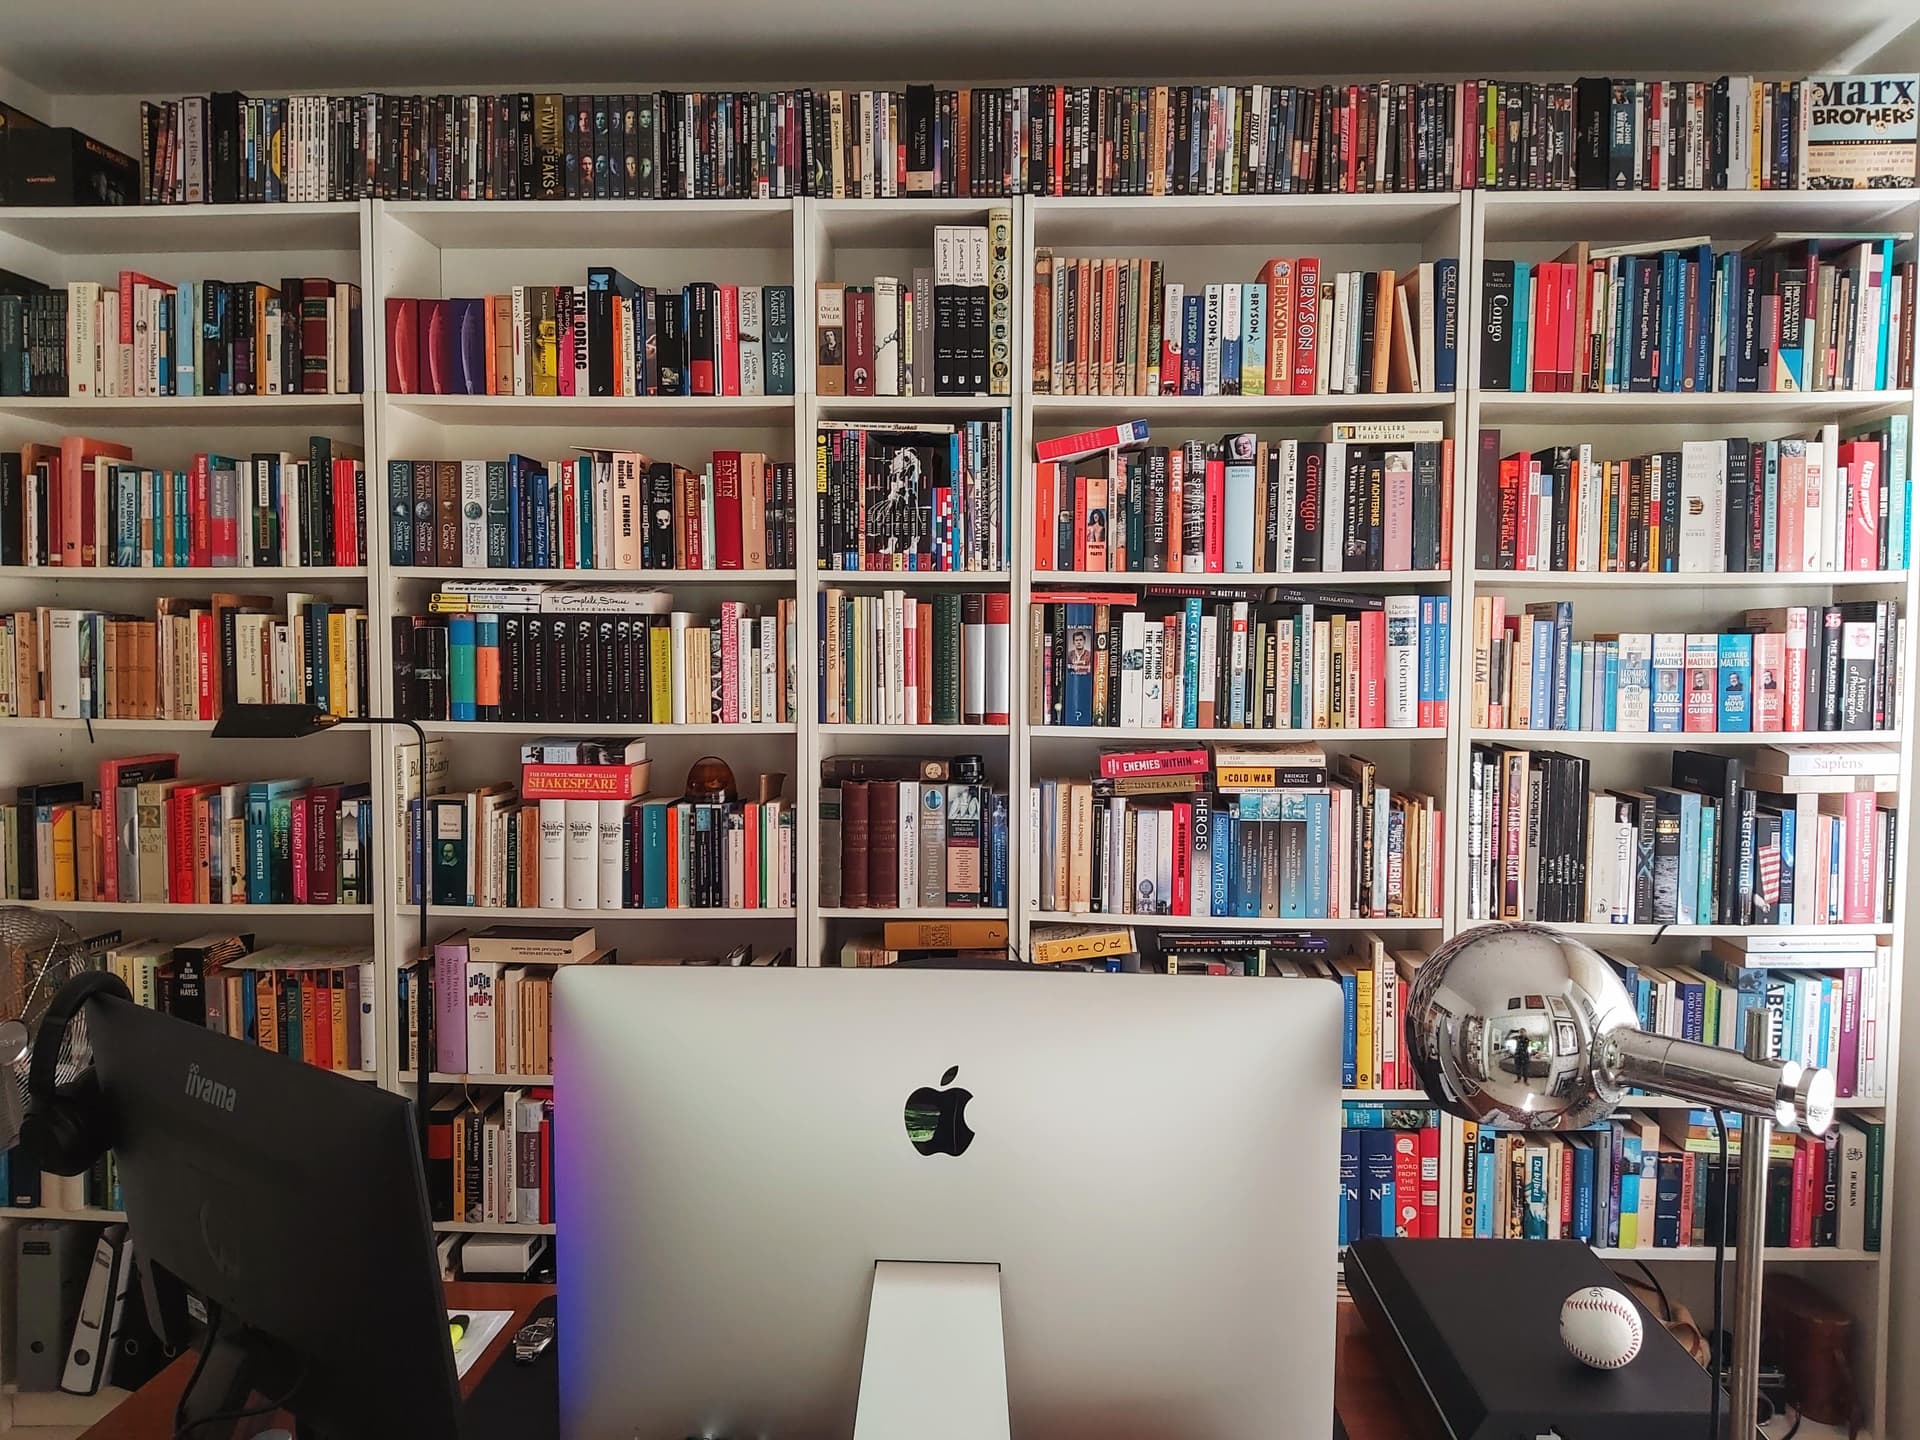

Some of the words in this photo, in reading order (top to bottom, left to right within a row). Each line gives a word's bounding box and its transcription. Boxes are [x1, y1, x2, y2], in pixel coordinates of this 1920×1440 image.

[1812, 80, 1915, 107] Marx
[542, 107, 554, 146] TWIN
[1250, 114, 1259, 146] DRIVE
[1616, 112, 1625, 144] WAYNE
[1812, 108, 1914, 125] BROTHERS
[542, 148, 554, 188] PEAKS
[743, 291, 751, 327] MARTIN
[771, 290, 779, 327] MARTIN
[1208, 294, 1217, 335] BRYSON
[1250, 293, 1258, 333] BRYSON
[1274, 286, 1288, 339] BRYSON
[1299, 274, 1315, 350] BRYSON
[1488, 295, 1508, 342] Congo
[1188, 306, 1197, 343] BRYSON
[1276, 340, 1284, 350] ONE
[771, 352, 779, 376] KINGS
[1276, 352, 1284, 378] SUMMER
[818, 446, 828, 493] WATCHMEN
[1155, 457, 1163, 484] BRUCE
[1172, 456, 1181, 492] BRUCE
[1193, 445, 1202, 475] BRUCE
[393, 464, 402, 497] MARTIN
[416, 465, 426, 499] MARTIN
[441, 465, 450, 499] MARTIN
[465, 465, 475, 499] MARTIN
[490, 466, 498, 501] MARTIN
[722, 460, 733, 497] RILKE
[1269, 482, 1278, 490] De
[1371, 469, 1379, 482] HET
[1632, 475, 1640, 491] DARK
[126, 493, 134, 508] DAN
[622, 495, 630, 510] EEN
[687, 479, 695, 516] DISCWORLD
[1269, 492, 1277, 506] man
[1300, 455, 1320, 531] Caravaggio
[1371, 483, 1379, 527] ACHTERHUIS
[1631, 496, 1639, 519] HORSE
[1664, 482, 1676, 523] story
[1155, 488, 1163, 543] SPRINGSTEEN
[1191, 478, 1201, 538] SPRINGSTEEN
[1269, 507, 1277, 520] van
[126, 510, 134, 539] BROWN
[396, 521, 404, 550] SWORDS
[419, 522, 427, 552] SWORDS
[442, 524, 450, 550] CROWS
[622, 513, 630, 537] HONGER
[1268, 521, 1278, 542] Apple
[1190, 601, 1198, 617] JIM
[1190, 623, 1198, 665] CARREY
[1475, 648, 1487, 682] FILM
[1655, 657, 1684, 665] MALTIN'S
[1687, 657, 1717, 665] MALTIN'S
[1720, 658, 1750, 667] MALTIN'S
[1829, 656, 1837, 693] POLAROID
[1368, 680, 1376, 706] Tonio
[1400, 650, 1409, 712] Reformatie
[1656, 692, 1681, 702] 2002
[1688, 706, 1714, 714] GUIDE
[1690, 692, 1713, 703] 2003
[1725, 704, 1744, 712] GUIDE
[1847, 675, 1857, 724] Photography
[1857, 684, 1866, 713] History
[1123, 759, 1160, 772] ENEMIES
[1162, 757, 1192, 769] WITHIN
[1229, 770, 1249, 782] COLD
[1254, 770, 1272, 783] WAR
[1813, 758, 1863, 773] Sapiens
[528, 777, 617, 790] SHAKESPEARE
[294, 812, 303, 848] Stephen
[1196, 798, 1207, 850] HEROES
[1216, 818, 1225, 846] Stephen
[1508, 806, 1520, 831] YEARS
[1216, 848, 1224, 859] Fry
[1616, 827, 1628, 862] Opera
[1389, 852, 1401, 895] AMERICA
[1507, 854, 1518, 880] OSCAR
[1215, 863, 1224, 905] MYTHOS
[179, 988, 198, 997] HAYES
[469, 973, 492, 988] JOTIE
[288, 993, 296, 1023] DUNE
[303, 993, 312, 1020] DUNE
[318, 991, 327, 1024] DUNE
[333, 992, 342, 1024] DUNE
[469, 992, 493, 1007] HOOFT
[1385, 982, 1393, 1018] WERK
[185, 1063, 236, 1112] iiyama
[1533, 1160, 1541, 1170] De
[1850, 1171, 1857, 1179] DE
[1532, 1172, 1541, 1196] bijbel
[1825, 1184, 1835, 1211] UFO
